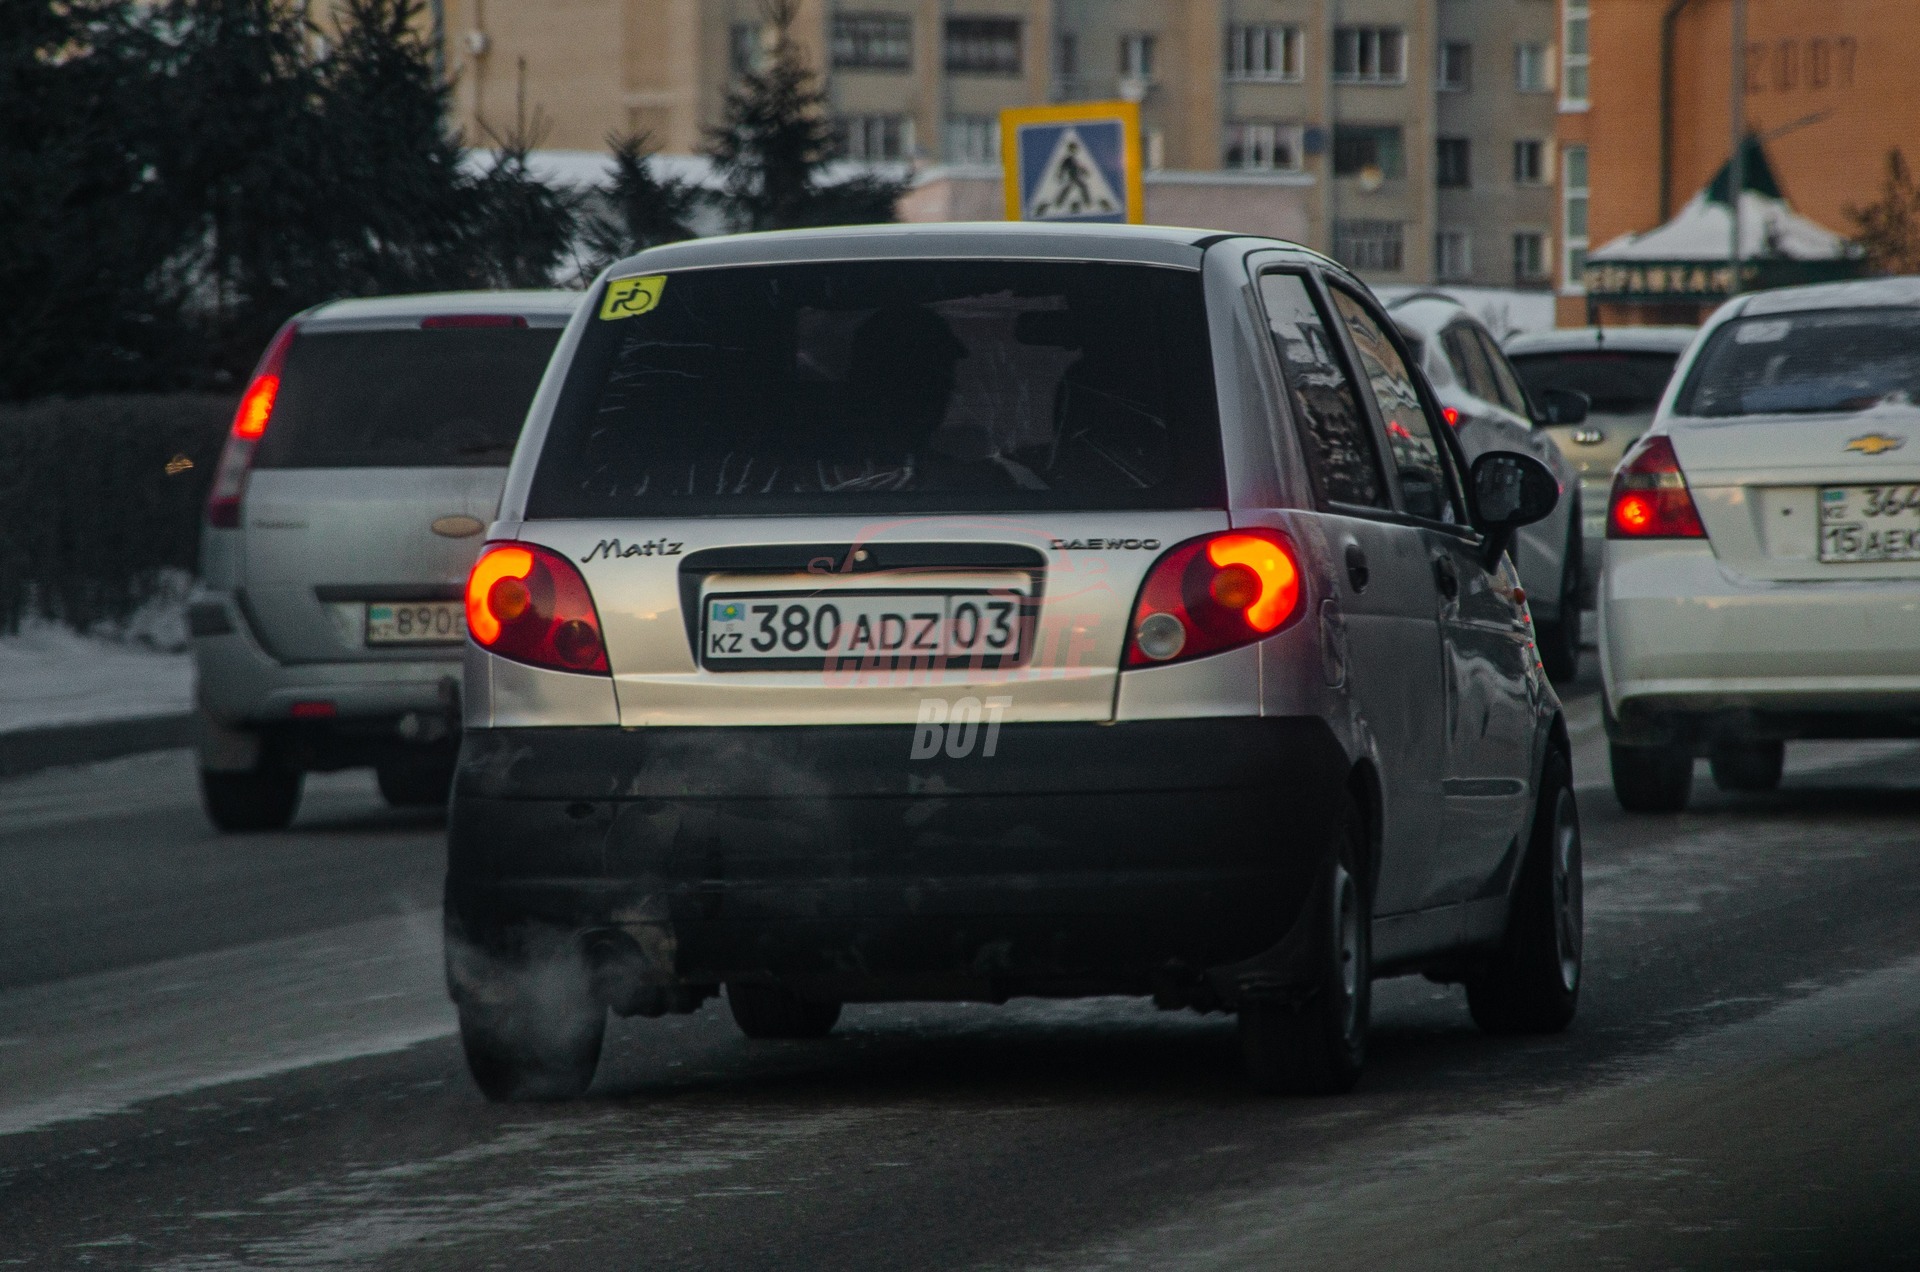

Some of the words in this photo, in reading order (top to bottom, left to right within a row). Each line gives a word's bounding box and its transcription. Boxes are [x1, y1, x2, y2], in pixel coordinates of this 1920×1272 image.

[581, 538, 683, 563] Matiz
[1049, 538, 1161, 550] DAEWOO
[711, 633, 743, 653] KZ
[954, 602, 1013, 649] 03
